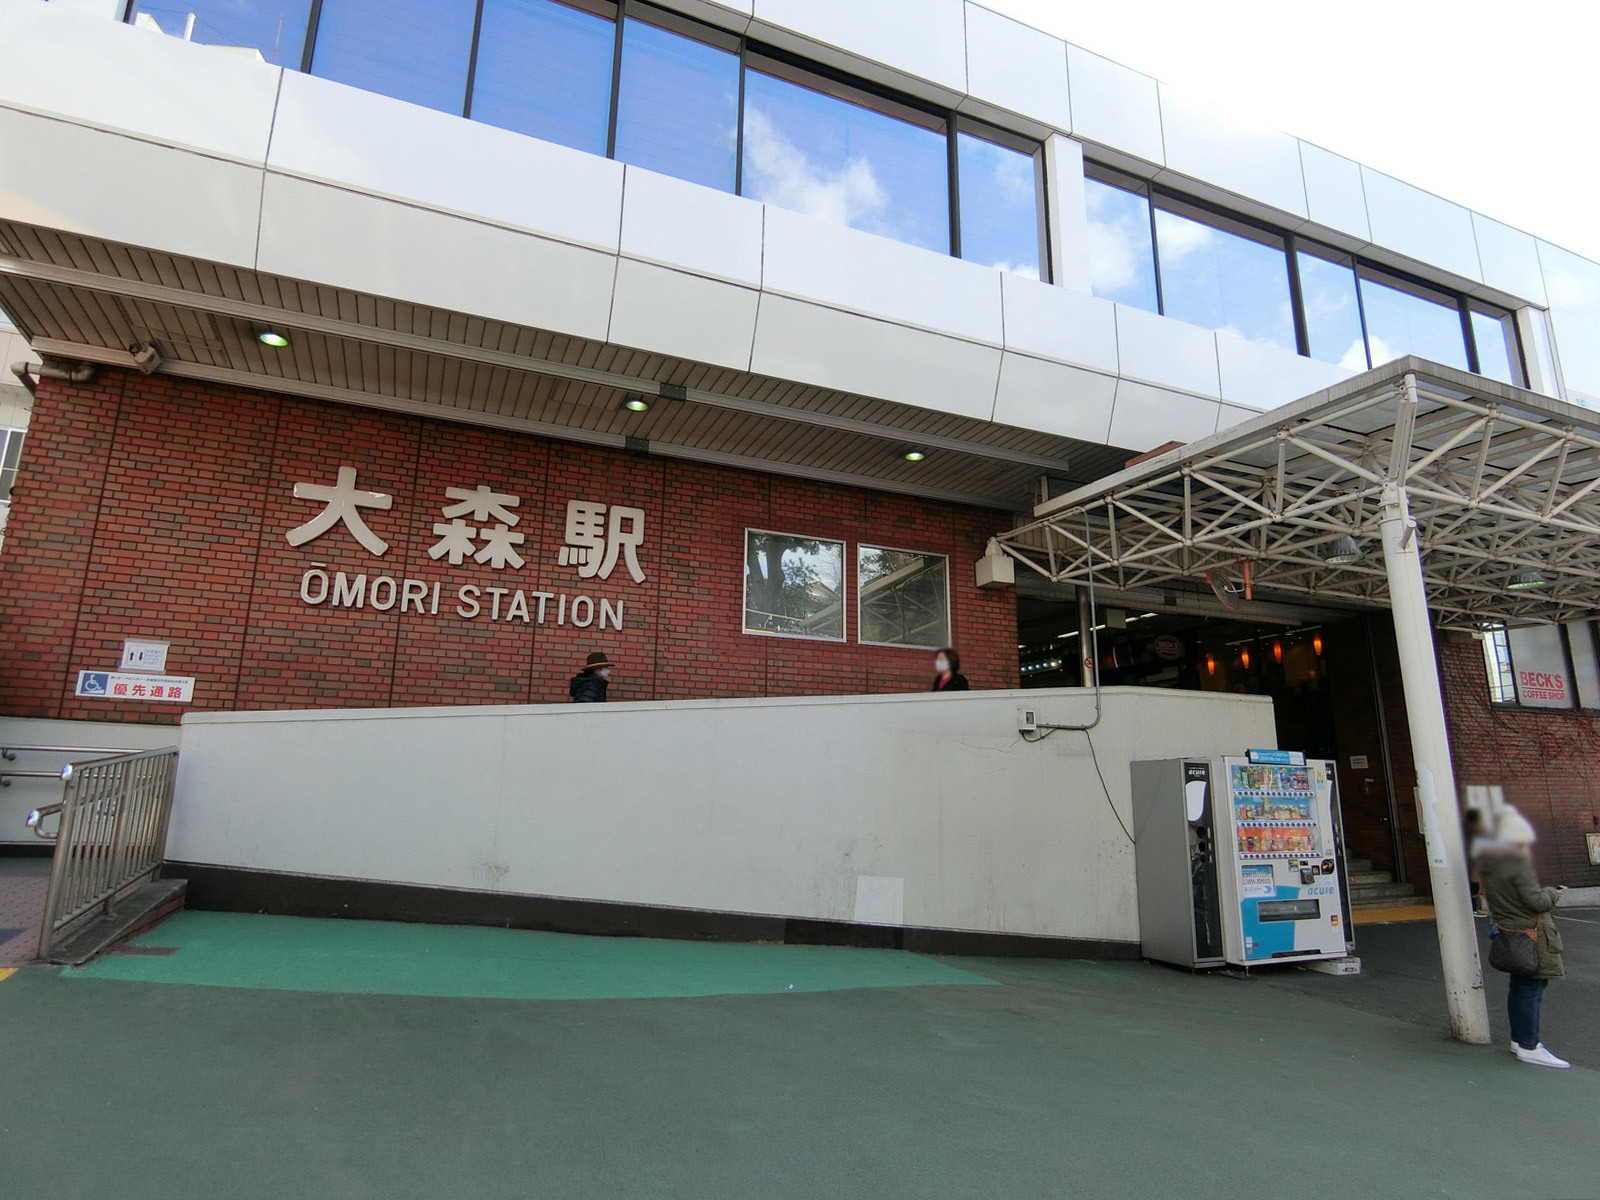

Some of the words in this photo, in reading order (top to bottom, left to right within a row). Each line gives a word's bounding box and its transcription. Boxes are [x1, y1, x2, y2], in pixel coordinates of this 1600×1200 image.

[285, 465, 646, 584] 大森駅
[300, 562, 441, 615] ŌMORI
[456, 585, 624, 631] STATION
[1519, 671, 1563, 689] BECK'S
[113, 683, 183, 699] 優先通路
[1523, 690, 1547, 699] COFFEE
[1548, 691, 1565, 700] SHOP
[1307, 886, 1335, 896] acure
